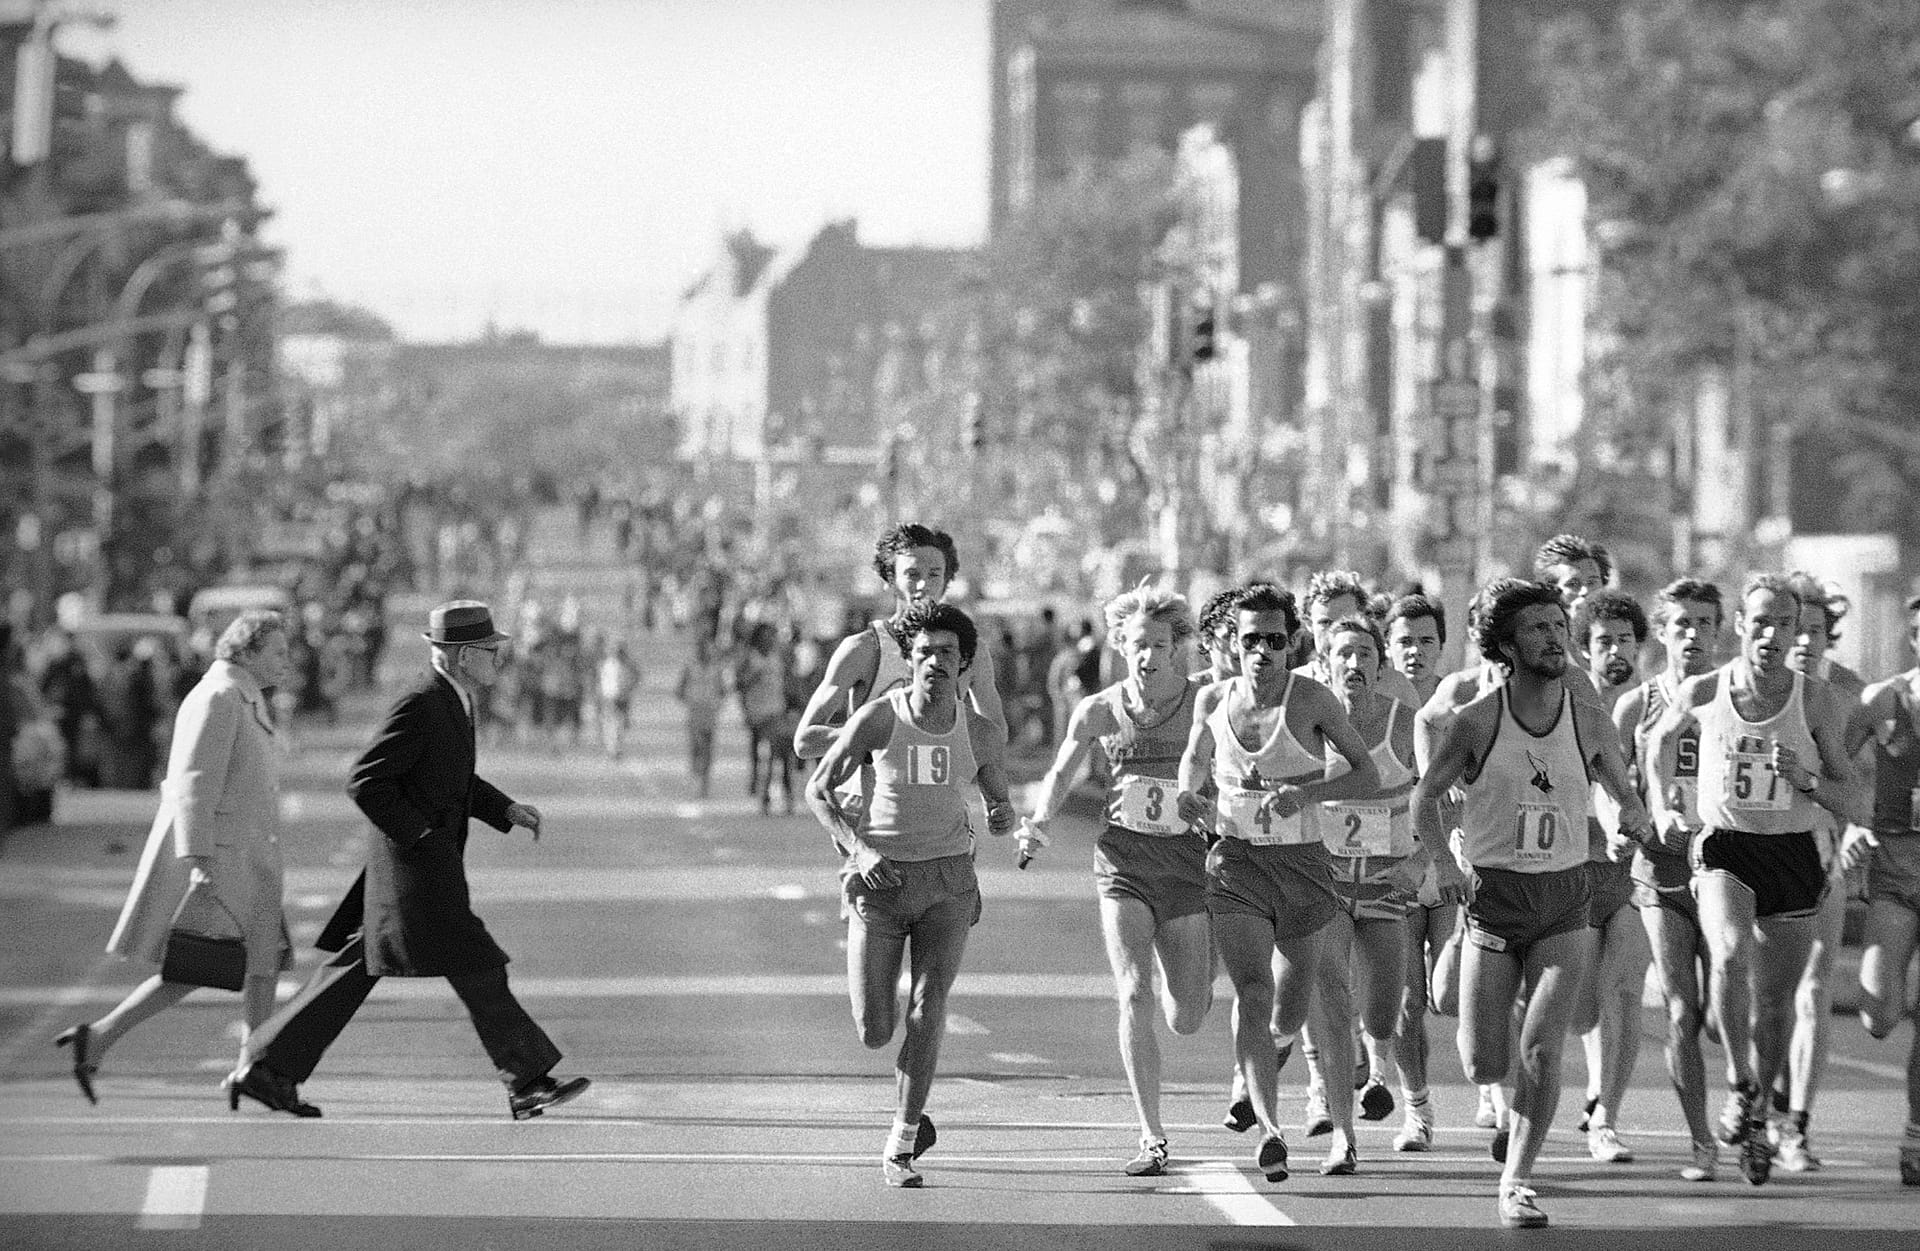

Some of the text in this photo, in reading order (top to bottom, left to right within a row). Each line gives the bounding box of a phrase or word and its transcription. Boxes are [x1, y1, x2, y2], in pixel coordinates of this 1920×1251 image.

[909, 746, 948, 784] 19
[1678, 737, 1697, 770] S
[1735, 761, 1777, 801] 57
[1145, 786, 1164, 822] 3
[1254, 799, 1272, 835] 4
[1344, 813, 1362, 848] 2
[1515, 811, 1556, 850] 10
